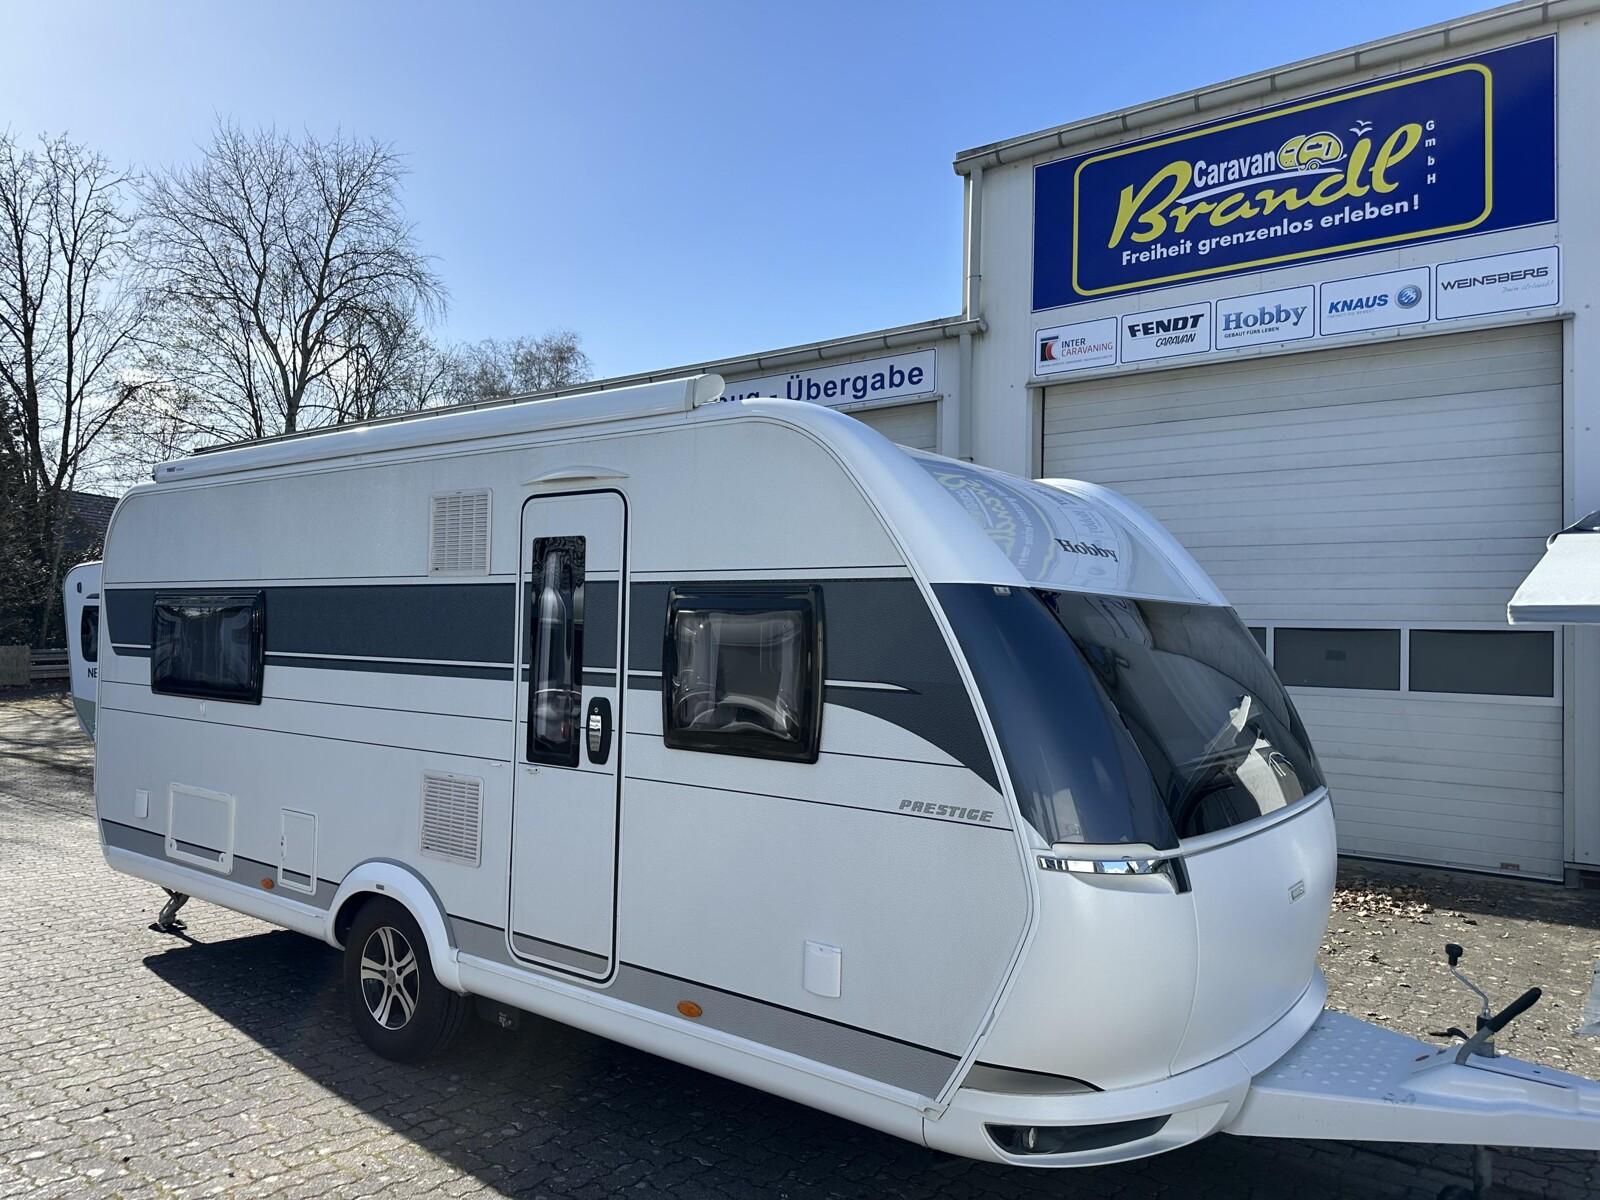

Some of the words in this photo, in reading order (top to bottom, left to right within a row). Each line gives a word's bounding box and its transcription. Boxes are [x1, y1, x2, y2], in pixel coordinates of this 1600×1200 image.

[1193, 148, 1276, 189] Caravan
[1108, 123, 1423, 248] Brandl
[1122, 239, 1192, 266] Freiheit
[1198, 218, 1313, 255] grenzenlos
[1320, 194, 1419, 228] erleben!
[1441, 266, 1549, 291] WEINSBERG
[1328, 294, 1389, 314] KNAUS
[1128, 313, 1205, 338] FENDT
[1222, 303, 1308, 332] Hobby
[1061, 337, 1086, 348] INTER
[1155, 333, 1197, 348] CARAVAN
[1224, 331, 1246, 339] GEBAUT
[1061, 342, 1113, 357] CARAVANING
[786, 364, 924, 401] Übergabe
[1054, 537, 1119, 563] Hobby
[898, 799, 994, 822] PRESTIGE
